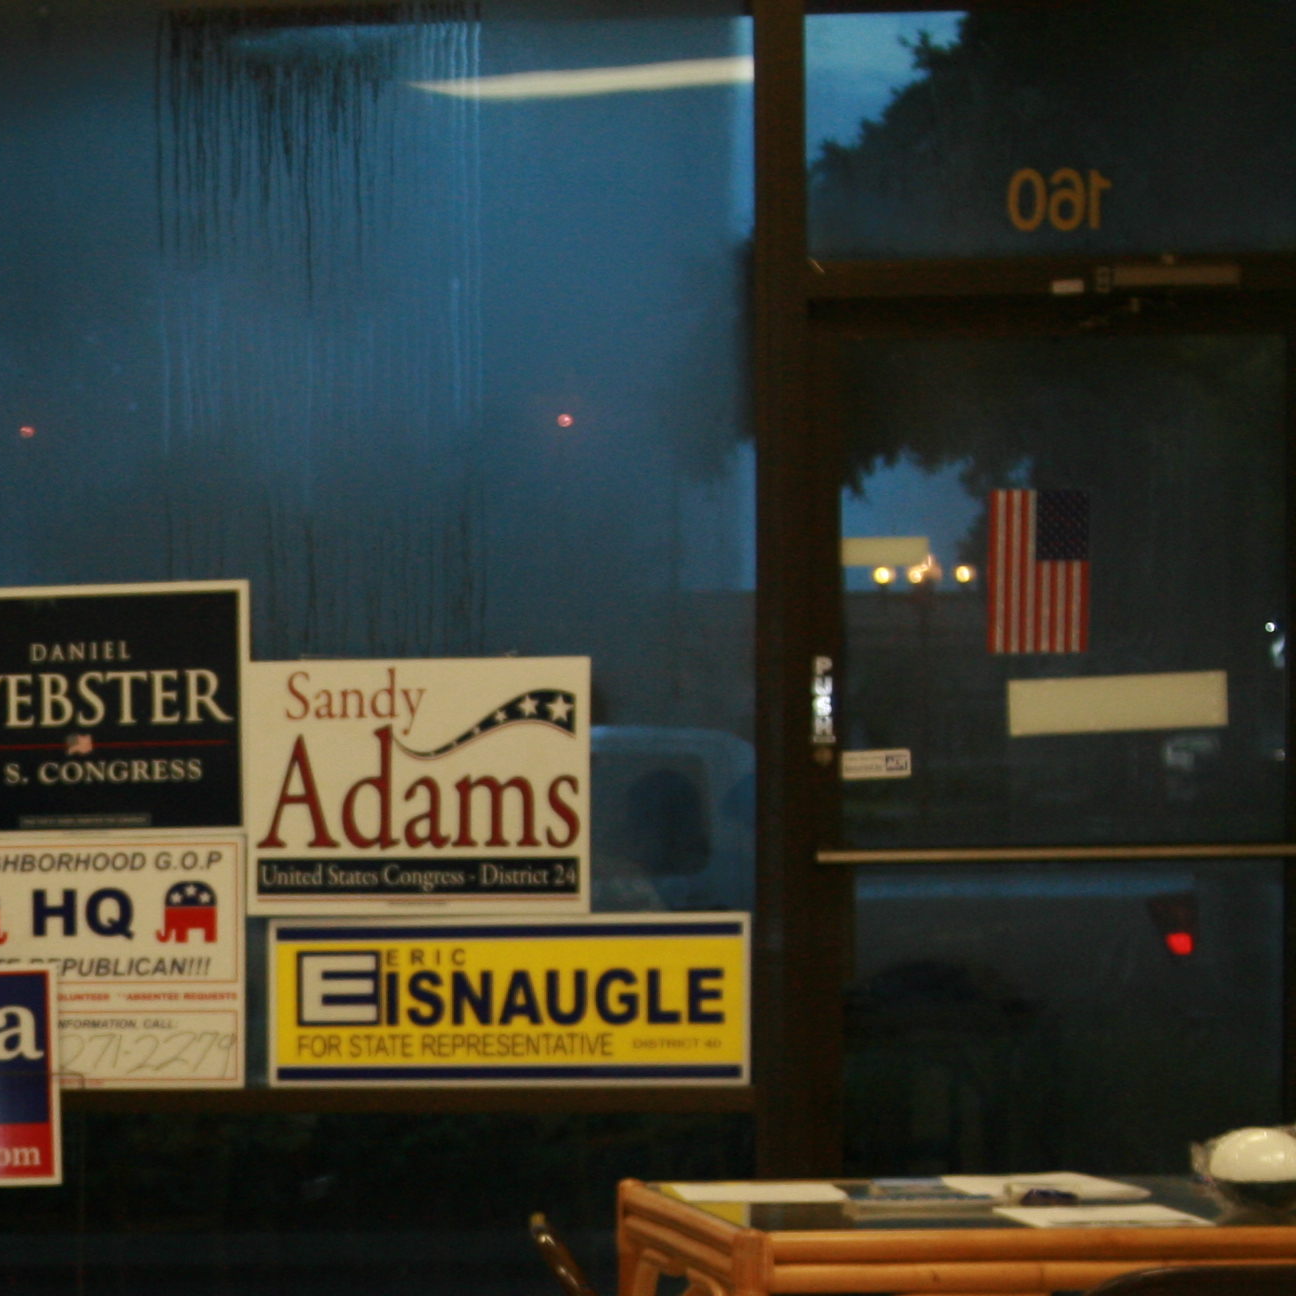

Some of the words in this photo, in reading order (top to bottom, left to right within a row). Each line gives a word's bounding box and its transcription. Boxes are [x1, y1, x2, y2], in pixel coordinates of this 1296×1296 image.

[29, 640, 130, 662] DANIEL
[286, 668, 426, 735] Sandy
[38, 758, 203, 783] CONGRESS
[256, 727, 581, 850] Adams
[261, 864, 322, 886] United
[327, 864, 378, 886] States
[384, 863, 465, 892] Congress
[481, 863, 549, 886] District
[554, 863, 577, 885] 24
[32, 887, 134, 940] HQ
[386, 949, 466, 966] ERIC
[297, 1034, 342, 1058] FOR
[349, 1034, 413, 1058] STATE
[421, 1032, 614, 1057] REPRESENTATIVE
